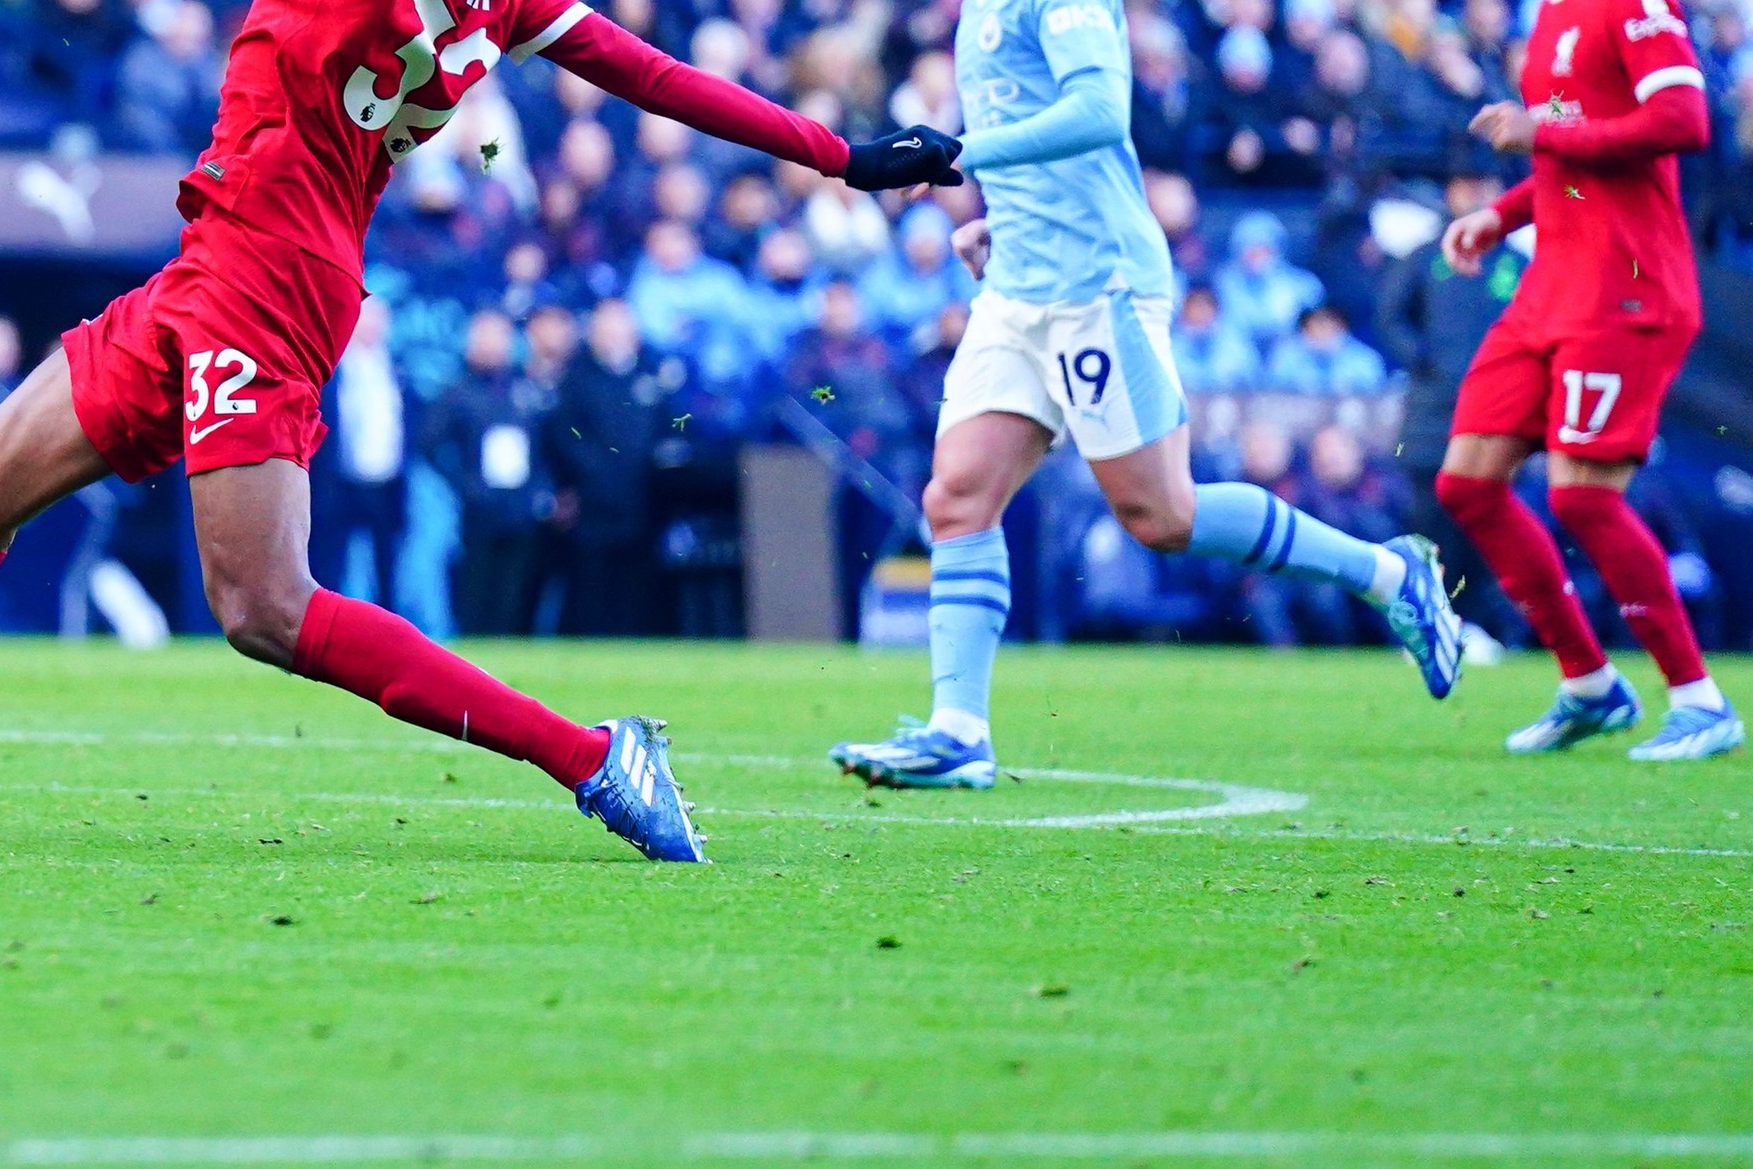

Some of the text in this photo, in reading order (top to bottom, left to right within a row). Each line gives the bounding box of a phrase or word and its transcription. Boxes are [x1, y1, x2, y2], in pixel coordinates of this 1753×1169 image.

[185, 348, 258, 422] 32
[1057, 348, 1112, 407] 19
[1563, 369, 1622, 432] 17
